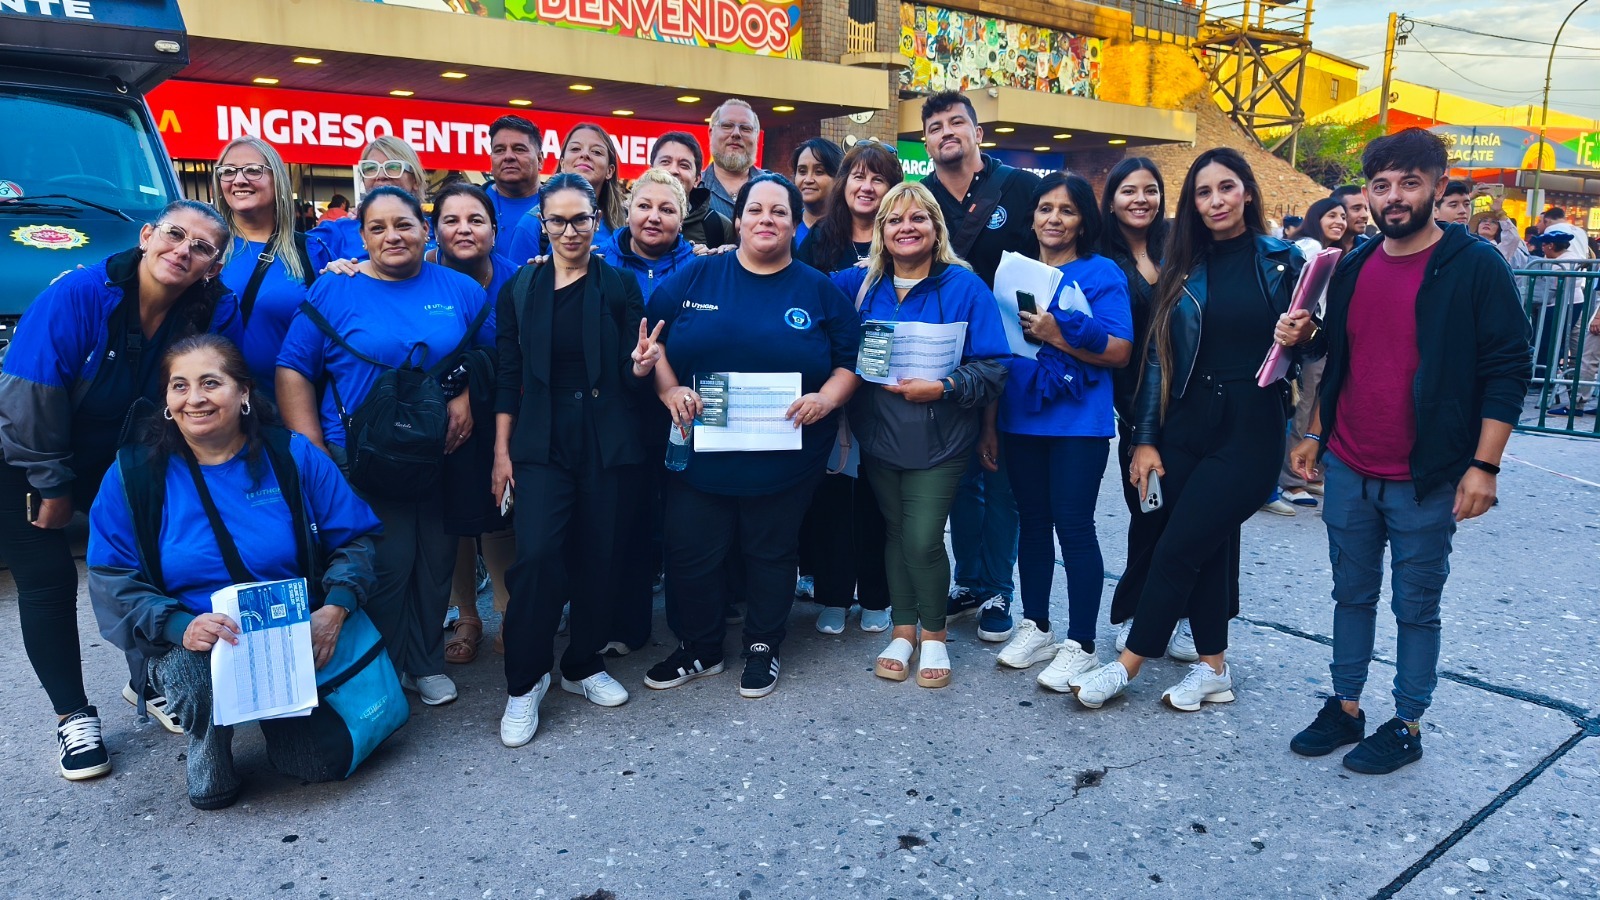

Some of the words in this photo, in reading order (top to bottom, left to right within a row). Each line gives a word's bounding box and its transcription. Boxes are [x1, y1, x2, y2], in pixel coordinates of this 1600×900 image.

[216, 105, 394, 148] INGRESO
[402, 118, 562, 160] ENTRA
[1460, 132, 1501, 146] MARÍA
[1447, 149, 1494, 161] SACATE
[898, 157, 935, 176] ARGÁ
